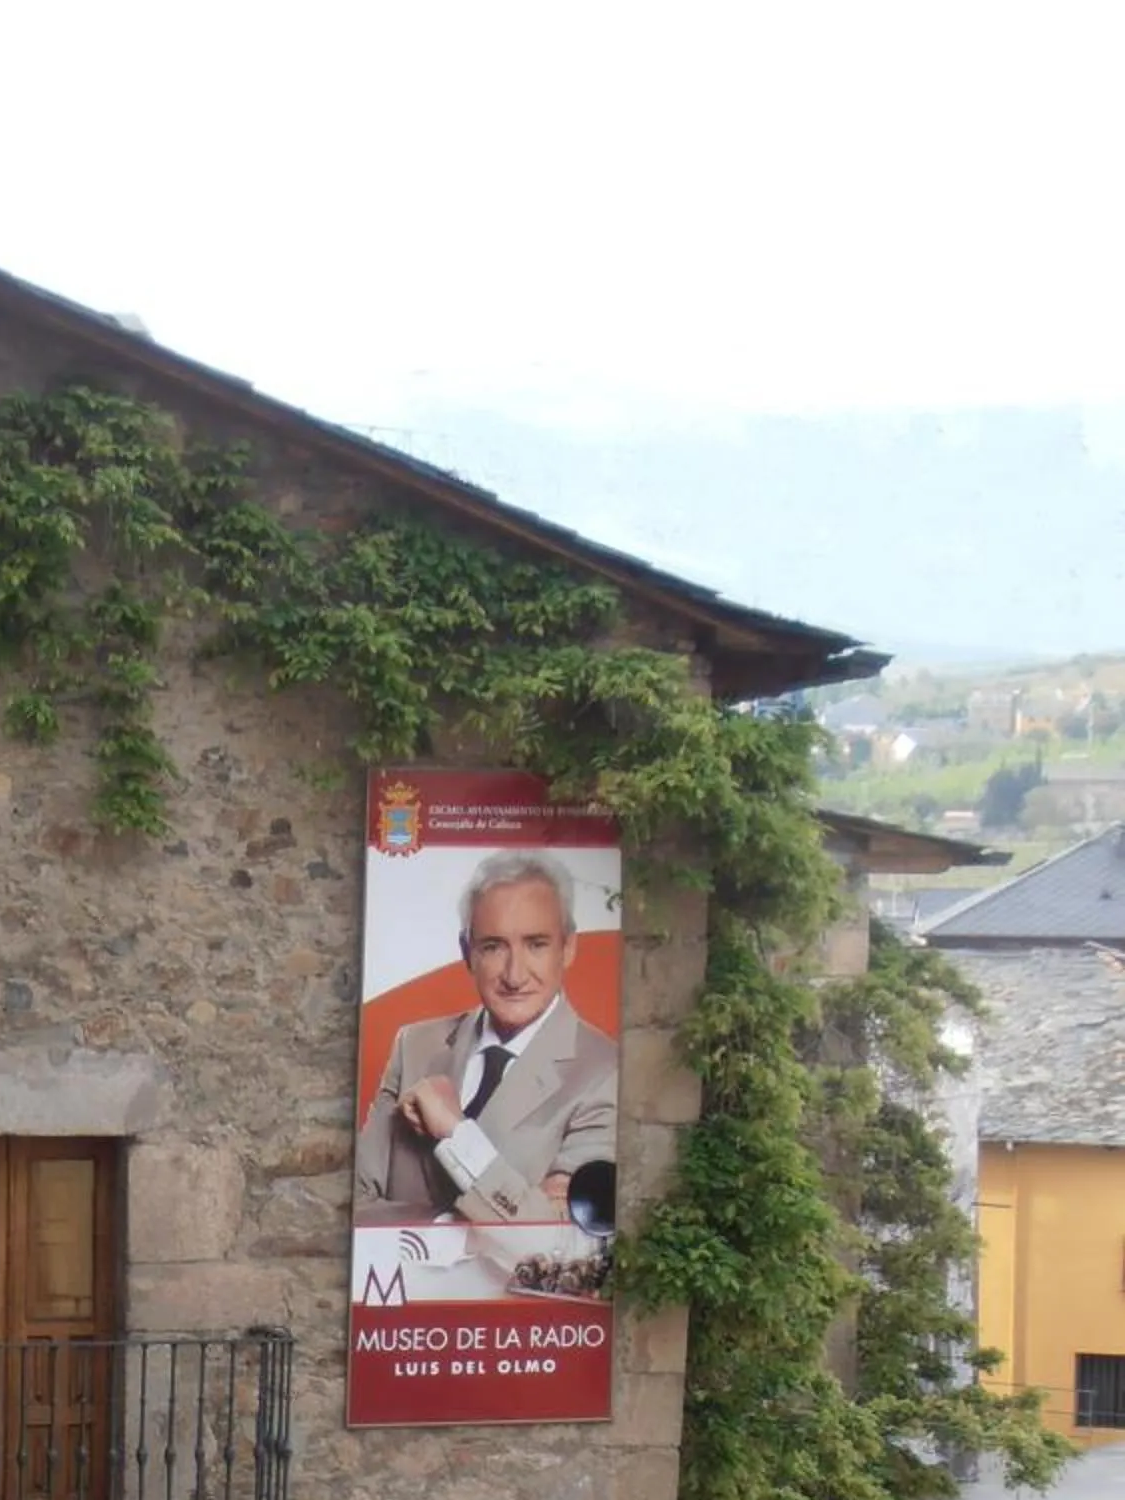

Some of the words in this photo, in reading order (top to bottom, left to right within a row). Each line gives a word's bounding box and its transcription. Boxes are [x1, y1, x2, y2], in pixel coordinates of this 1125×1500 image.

[362, 1263, 407, 1306] M
[356, 1327, 448, 1351] MUSEO
[456, 1327, 486, 1350] DE
[495, 1327, 522, 1349] LA
[530, 1325, 605, 1348] RADIO
[394, 1361, 440, 1376] LUIS
[451, 1361, 486, 1375] DEL
[497, 1359, 556, 1373] OLMO
